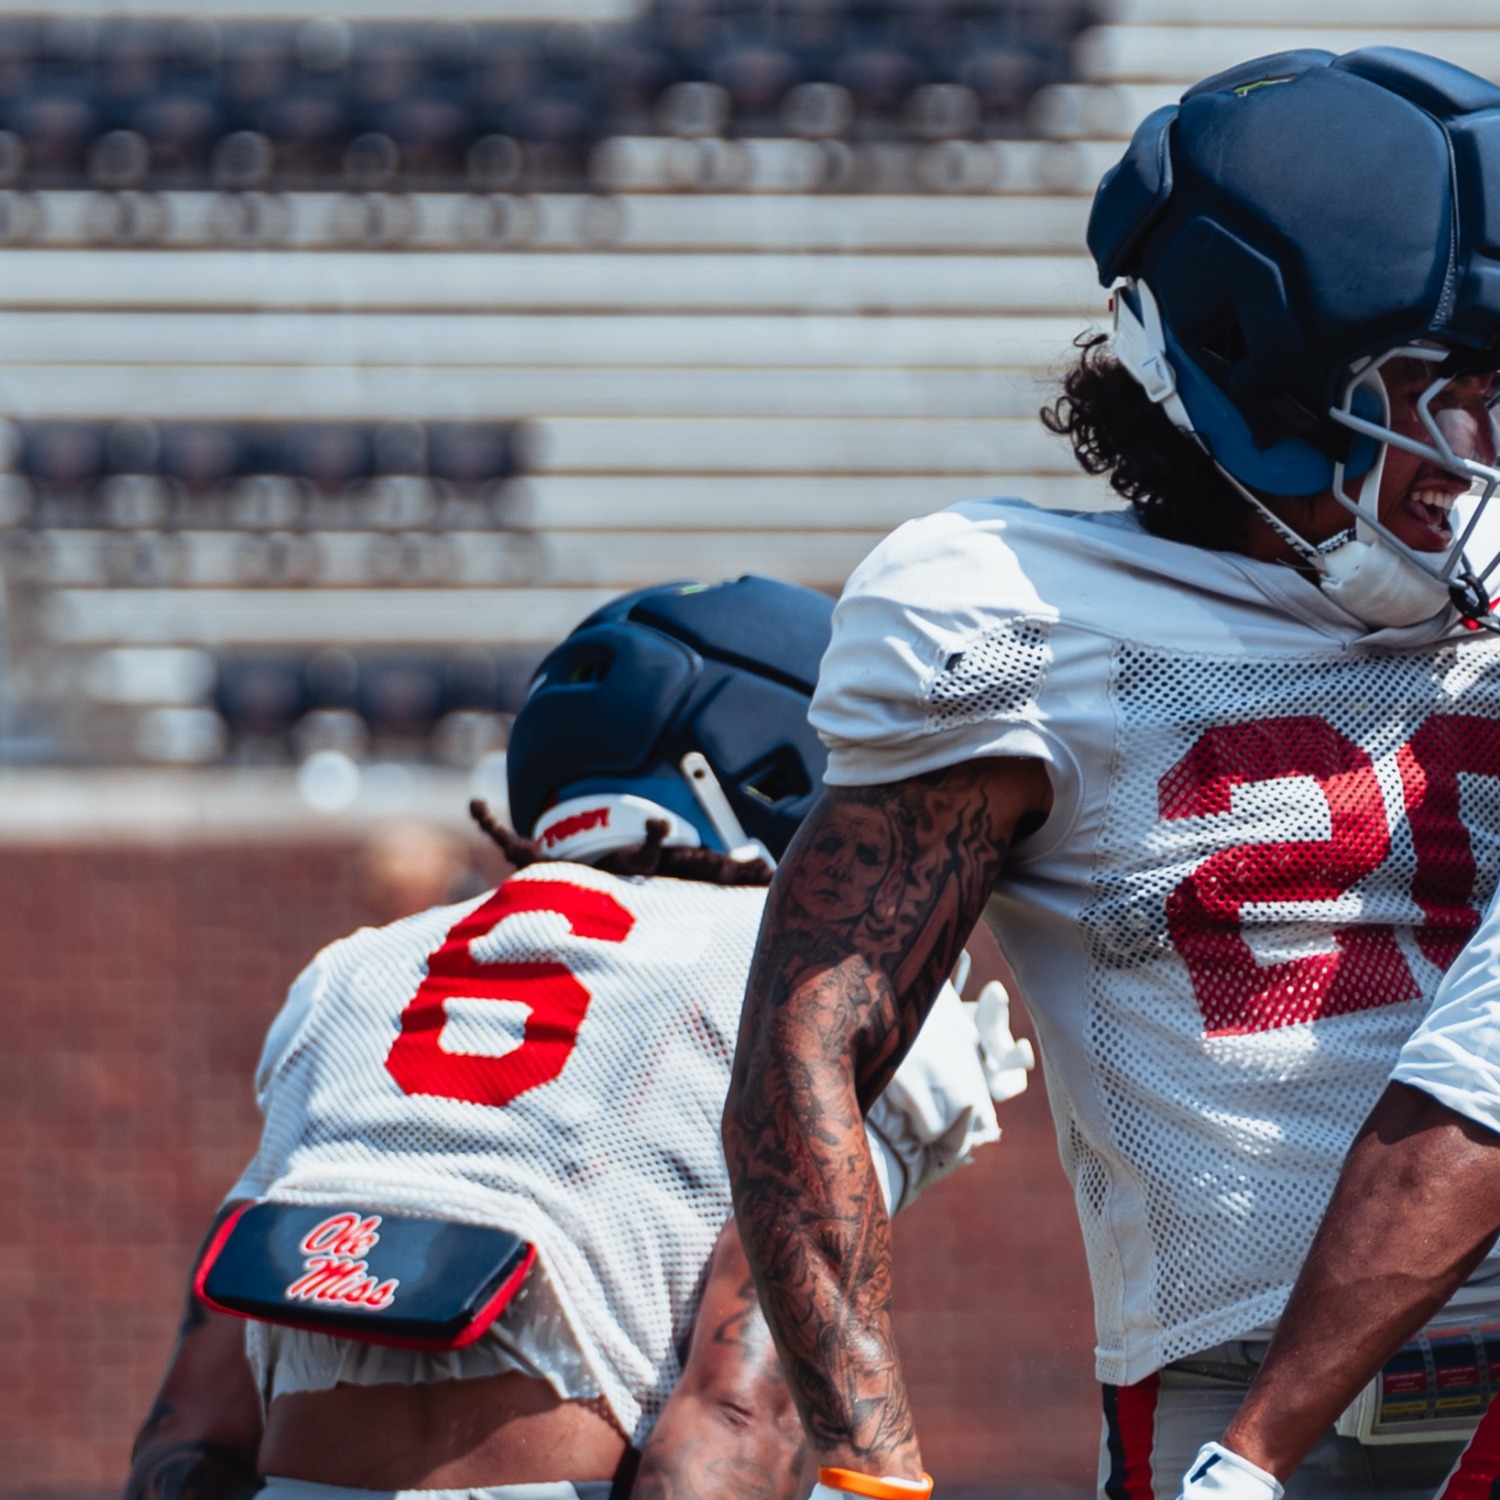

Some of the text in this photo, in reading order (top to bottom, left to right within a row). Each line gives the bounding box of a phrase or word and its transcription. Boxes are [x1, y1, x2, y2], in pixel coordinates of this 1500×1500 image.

[383, 878, 636, 1107] 6
[299, 1211, 382, 1259] Ole
[284, 1255, 400, 1311] Miss
